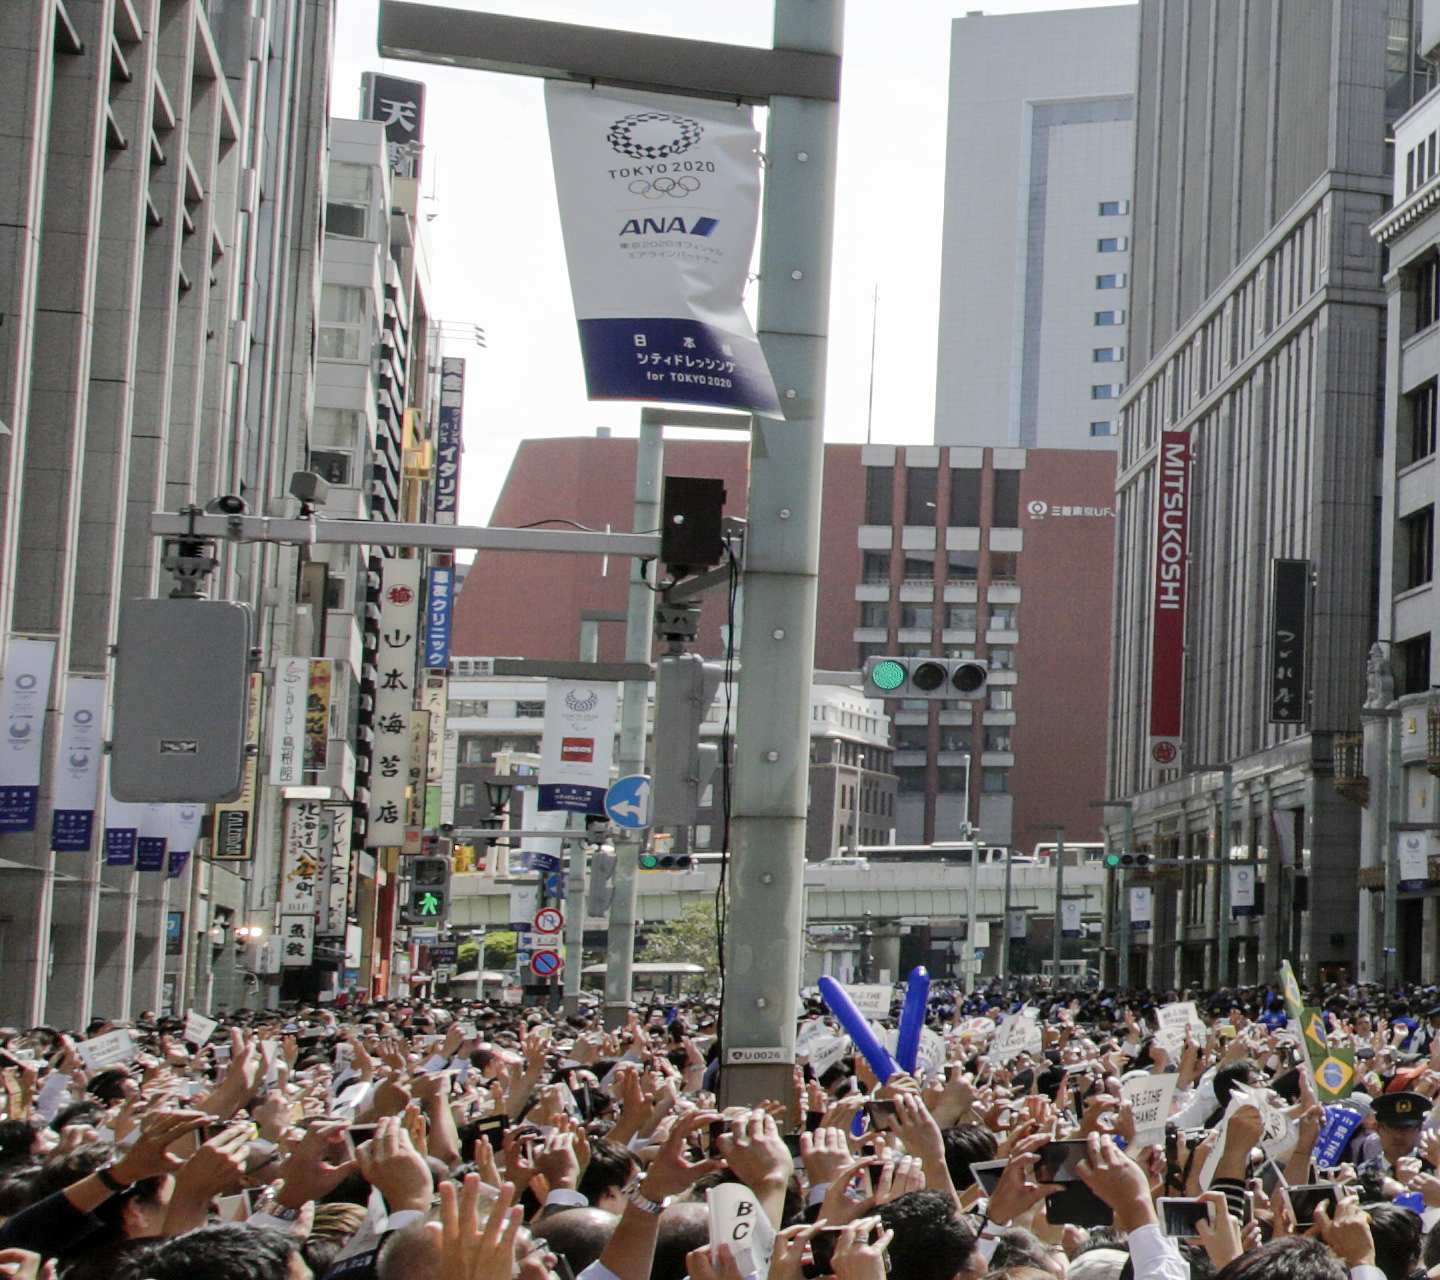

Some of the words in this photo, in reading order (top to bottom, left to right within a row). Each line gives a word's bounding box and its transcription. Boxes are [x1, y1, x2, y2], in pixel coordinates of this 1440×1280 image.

[608, 164, 667, 179] TOKYO
[672, 161, 715, 173] 2020
[619, 217, 687, 236] ANA
[646, 371, 665, 382] for
[670, 372, 706, 386] TOKYO
[707, 376, 732, 388] 2020
[1160, 444, 1185, 608] MITSUKOSHI
[374, 628, 412, 824] 山本海苔店
[1324, 1140, 1340, 1159] THE
[737, 1201, 752, 1217] B
